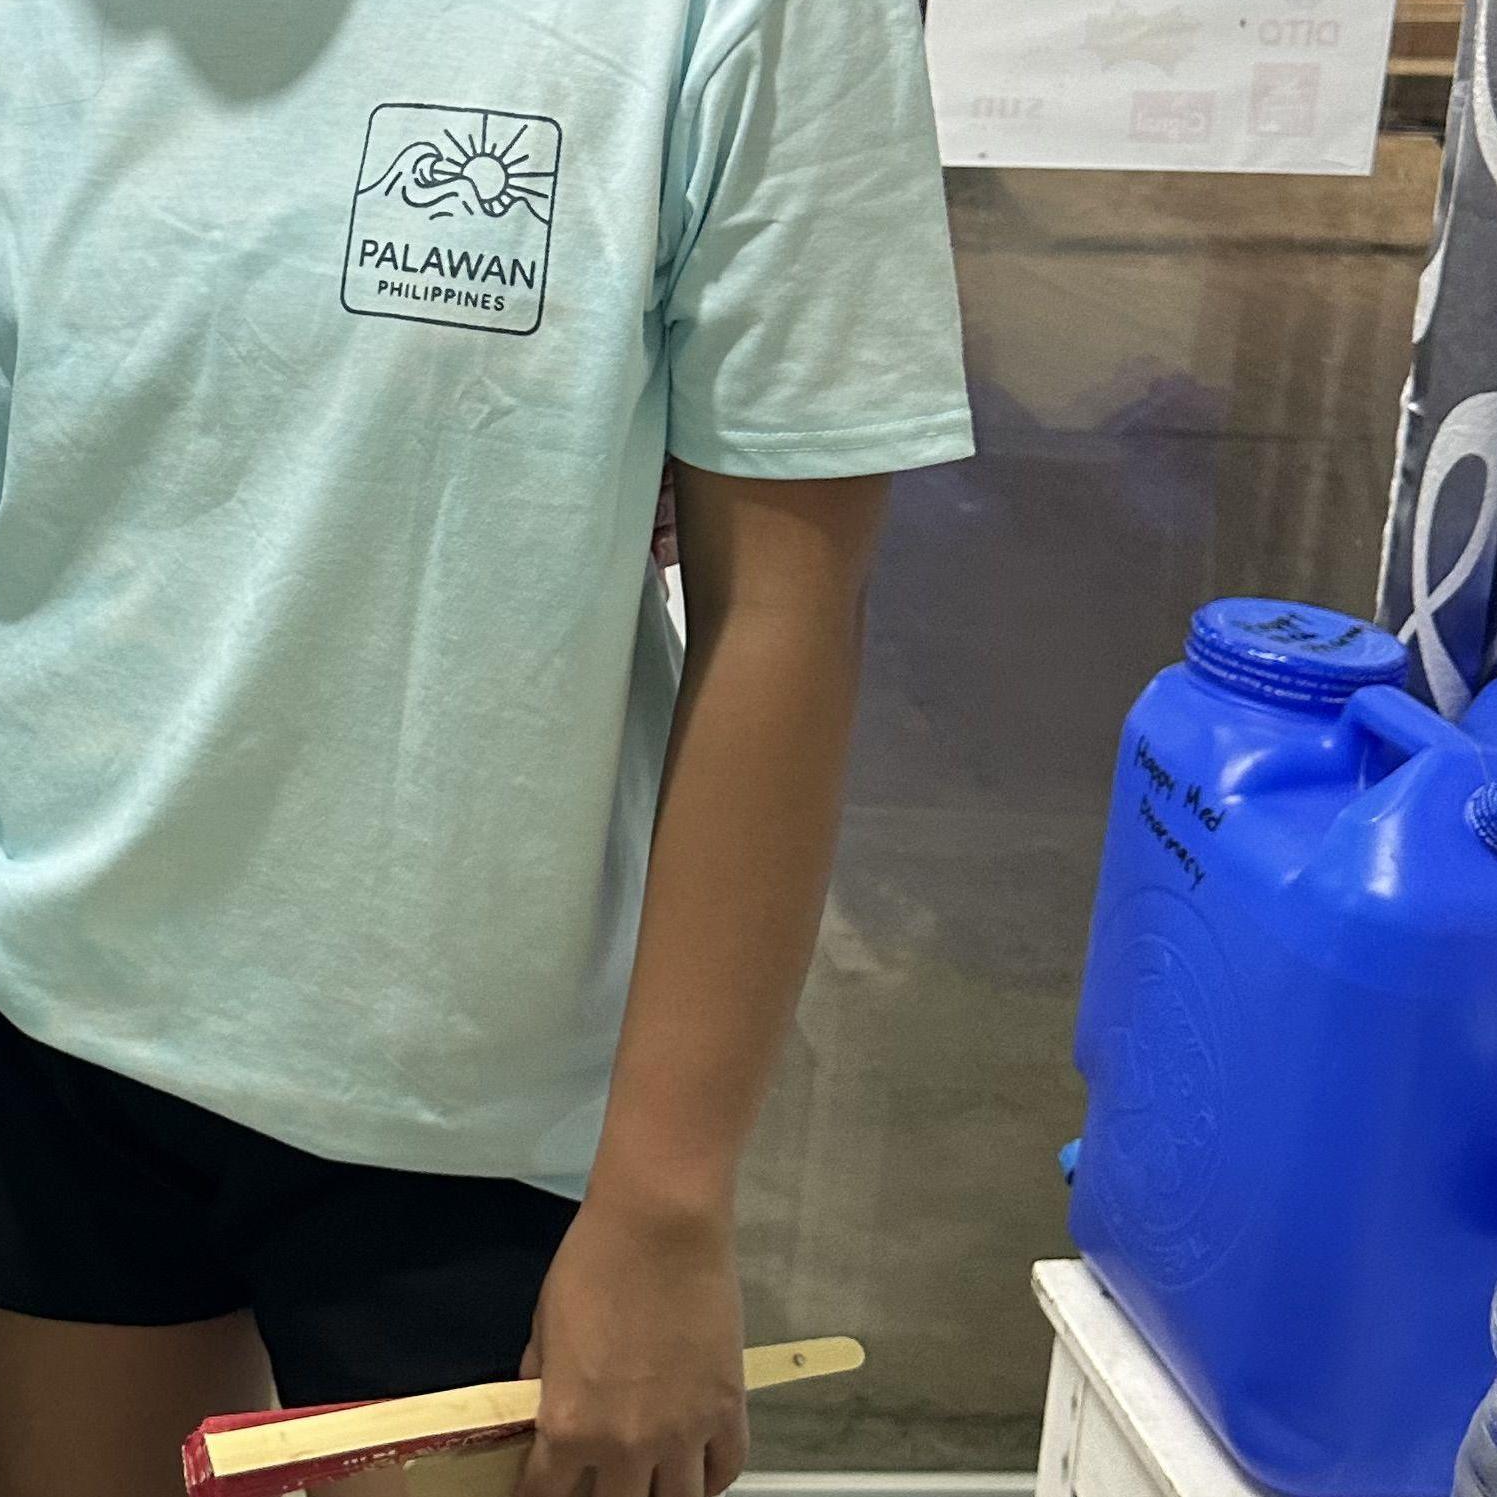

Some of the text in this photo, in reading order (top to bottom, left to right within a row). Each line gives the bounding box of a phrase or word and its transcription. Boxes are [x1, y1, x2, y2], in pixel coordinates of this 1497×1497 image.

[359, 238, 536, 289] PALAWAN
[377, 279, 506, 312] PHILIPPINES
[1133, 734, 1228, 833] Happy Med
